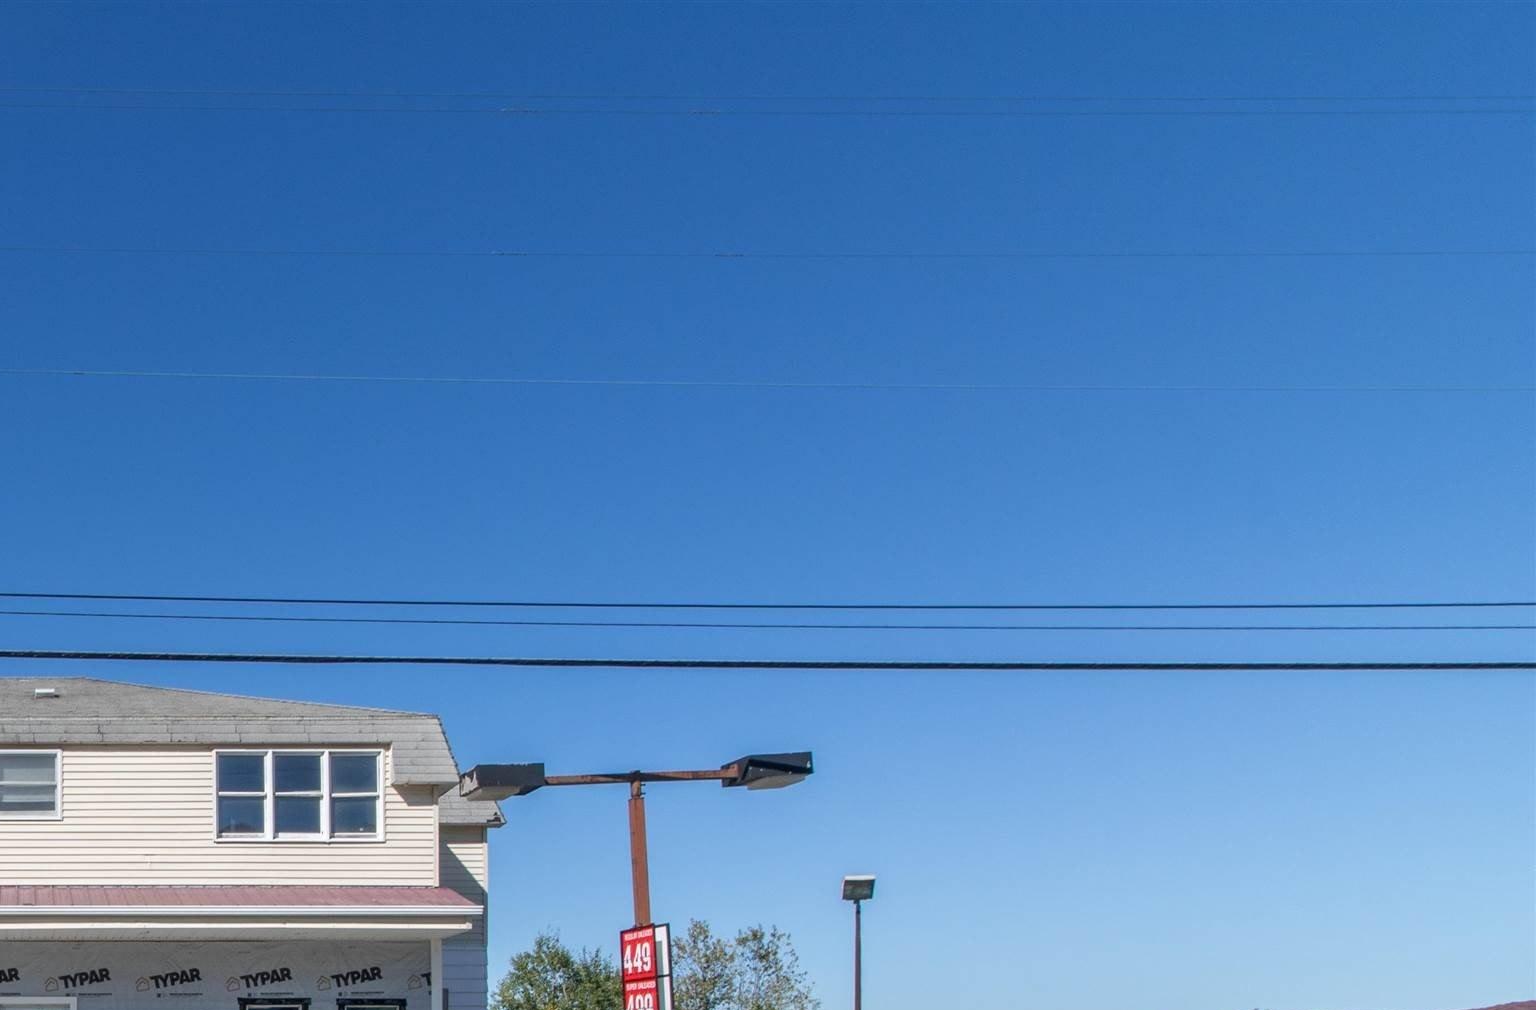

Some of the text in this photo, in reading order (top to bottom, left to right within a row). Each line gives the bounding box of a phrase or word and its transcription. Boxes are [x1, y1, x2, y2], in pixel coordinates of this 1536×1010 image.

[59, 968, 111, 989] TYPAR
[150, 968, 202, 989] TYPAR
[240, 967, 292, 989] TYPAR
[331, 967, 383, 988] TYPAR
